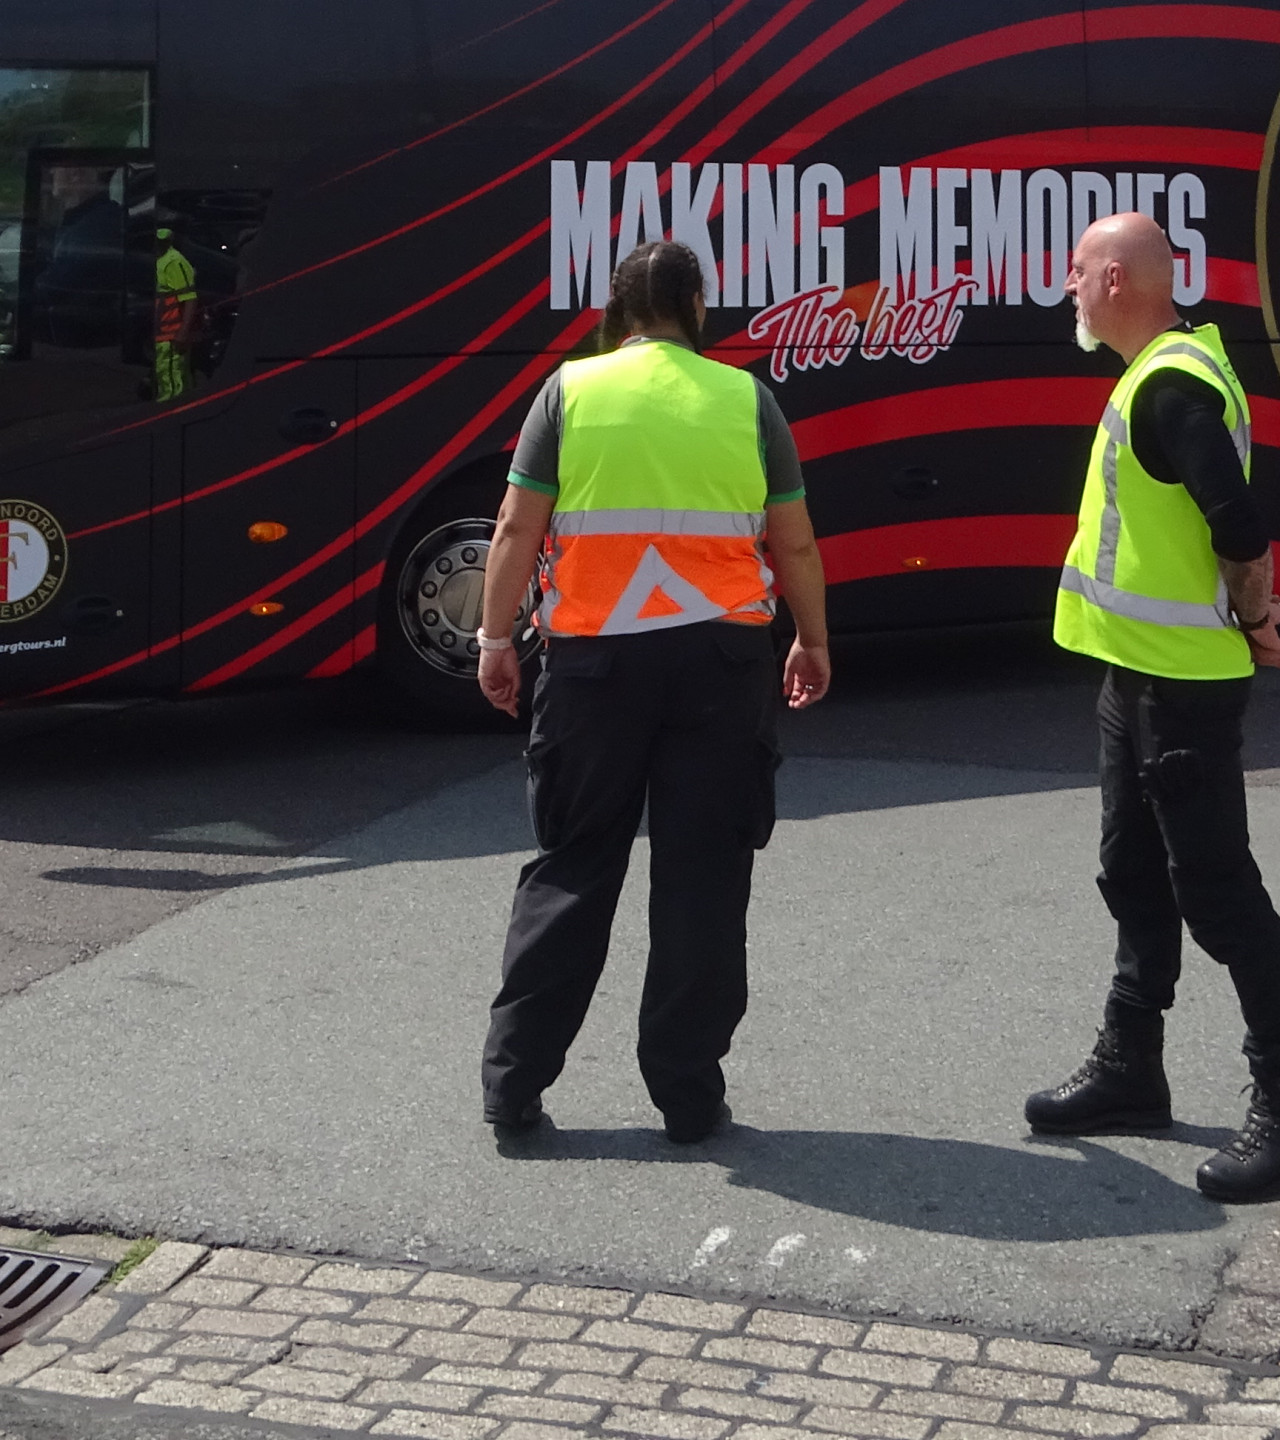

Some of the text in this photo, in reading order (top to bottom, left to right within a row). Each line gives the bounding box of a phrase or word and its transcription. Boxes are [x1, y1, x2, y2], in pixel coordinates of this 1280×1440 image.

[550, 159, 845, 311] MAKING
[748, 273, 981, 383] The best
